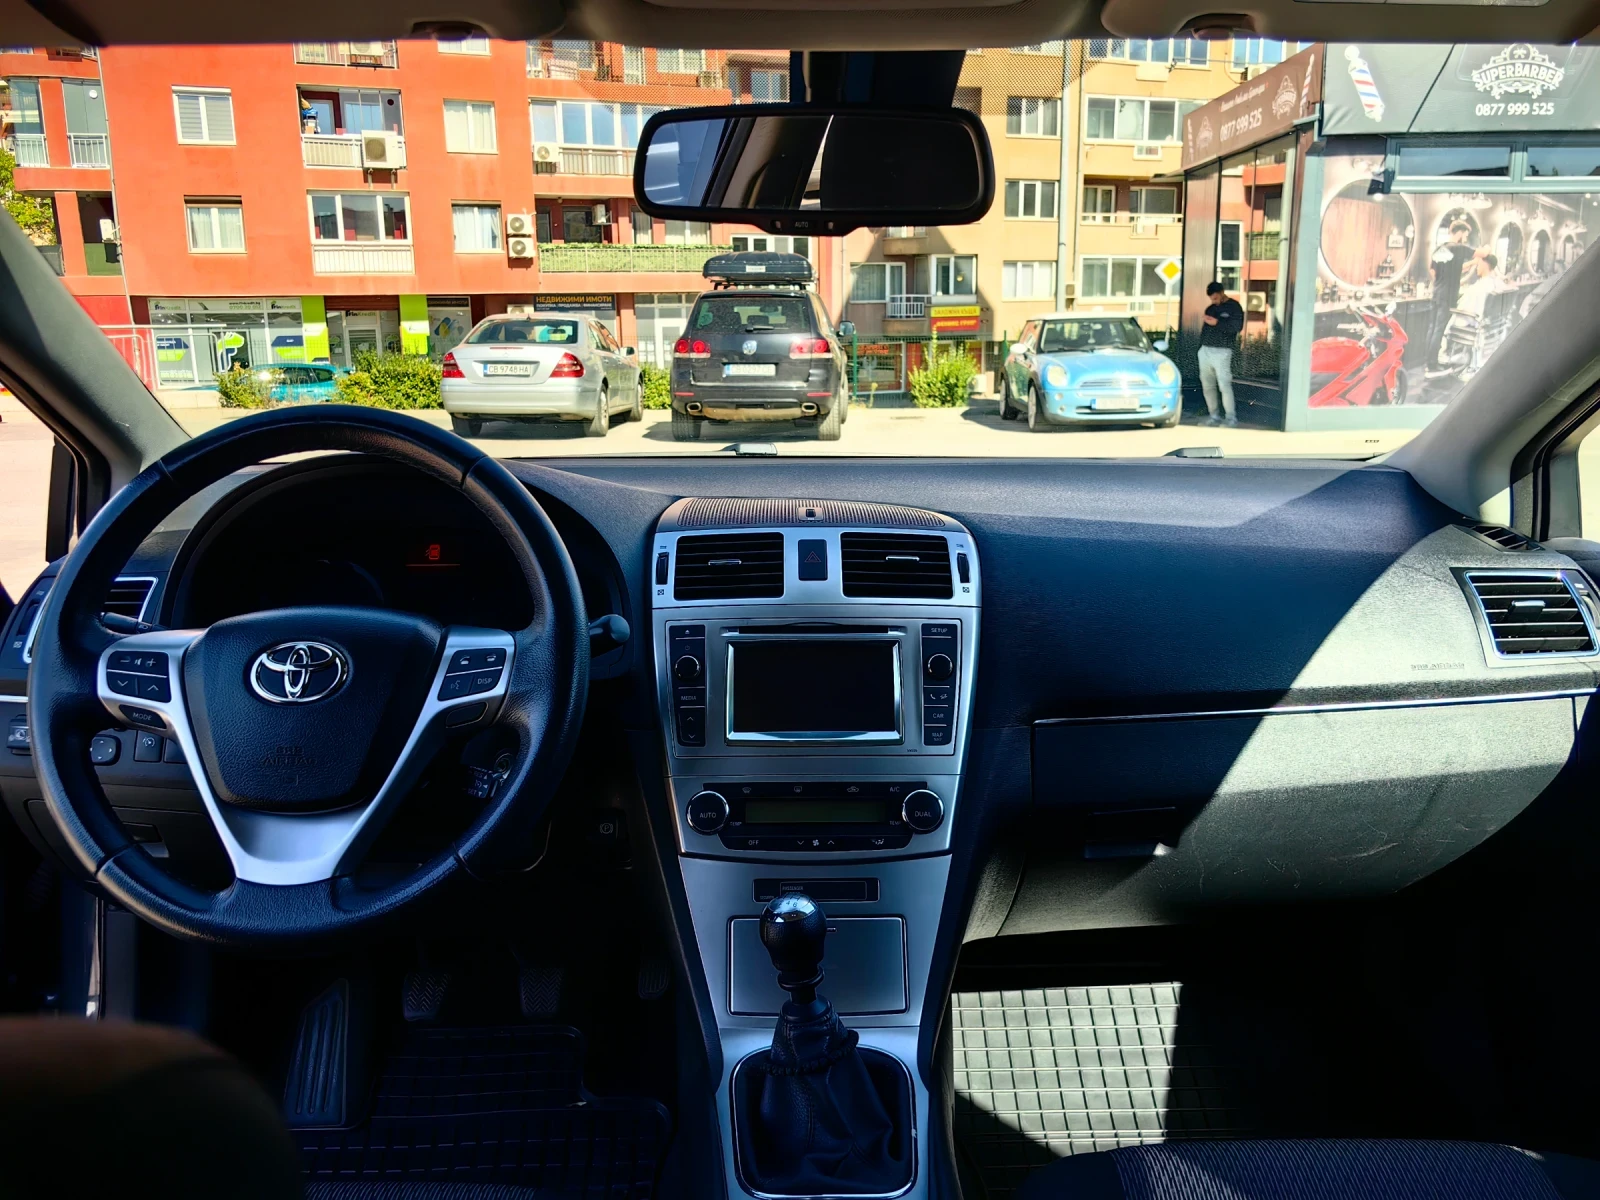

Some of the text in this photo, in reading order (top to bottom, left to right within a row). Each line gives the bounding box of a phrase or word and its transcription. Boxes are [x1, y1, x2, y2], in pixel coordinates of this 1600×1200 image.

[1472, 62, 1564, 88] SUPERBARBER
[1475, 102, 1555, 116] 0877 999 525
[1236, 114, 1249, 135] 999
[1249, 108, 1262, 130] 525
[477, 677, 493, 685] DISP
[132, 711, 153, 721] MODE
[699, 811, 717, 819] AUTO
[914, 810, 932, 818] DUAL
